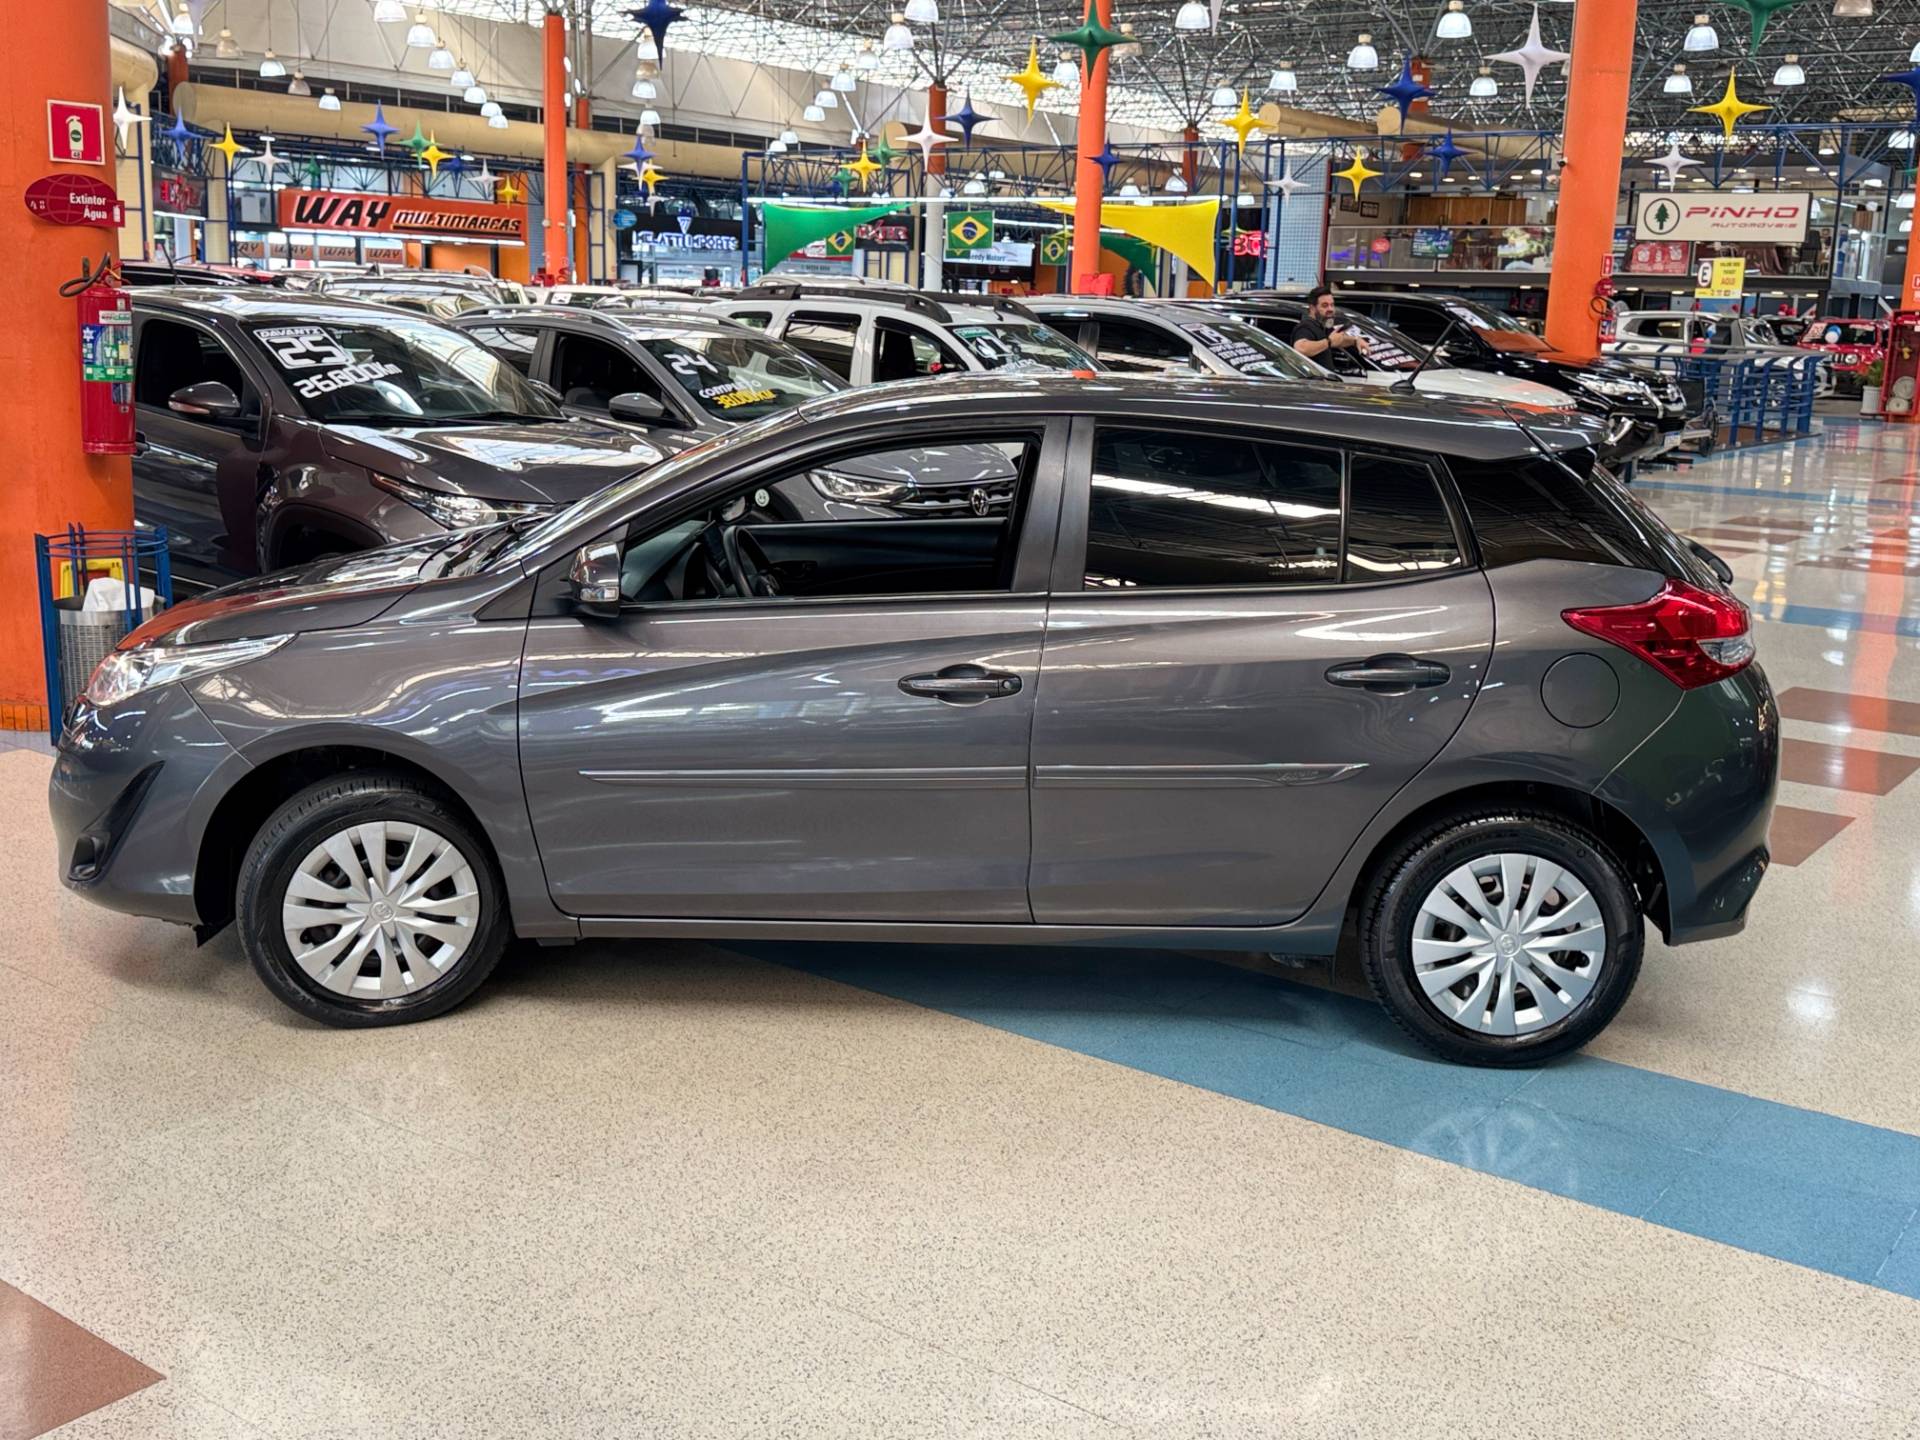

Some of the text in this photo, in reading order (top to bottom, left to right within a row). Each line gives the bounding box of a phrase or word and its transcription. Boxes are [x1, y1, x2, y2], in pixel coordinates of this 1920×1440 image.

[69, 192, 106, 206] Extintor
[83, 204, 108, 221] Água
[293, 195, 391, 228] WAY
[323, 245, 355, 257] WAY
[368, 247, 400, 259] WAY
[1701, 266, 1709, 283] E
[268, 336, 347, 364] 25
[663, 353, 718, 375] 24
